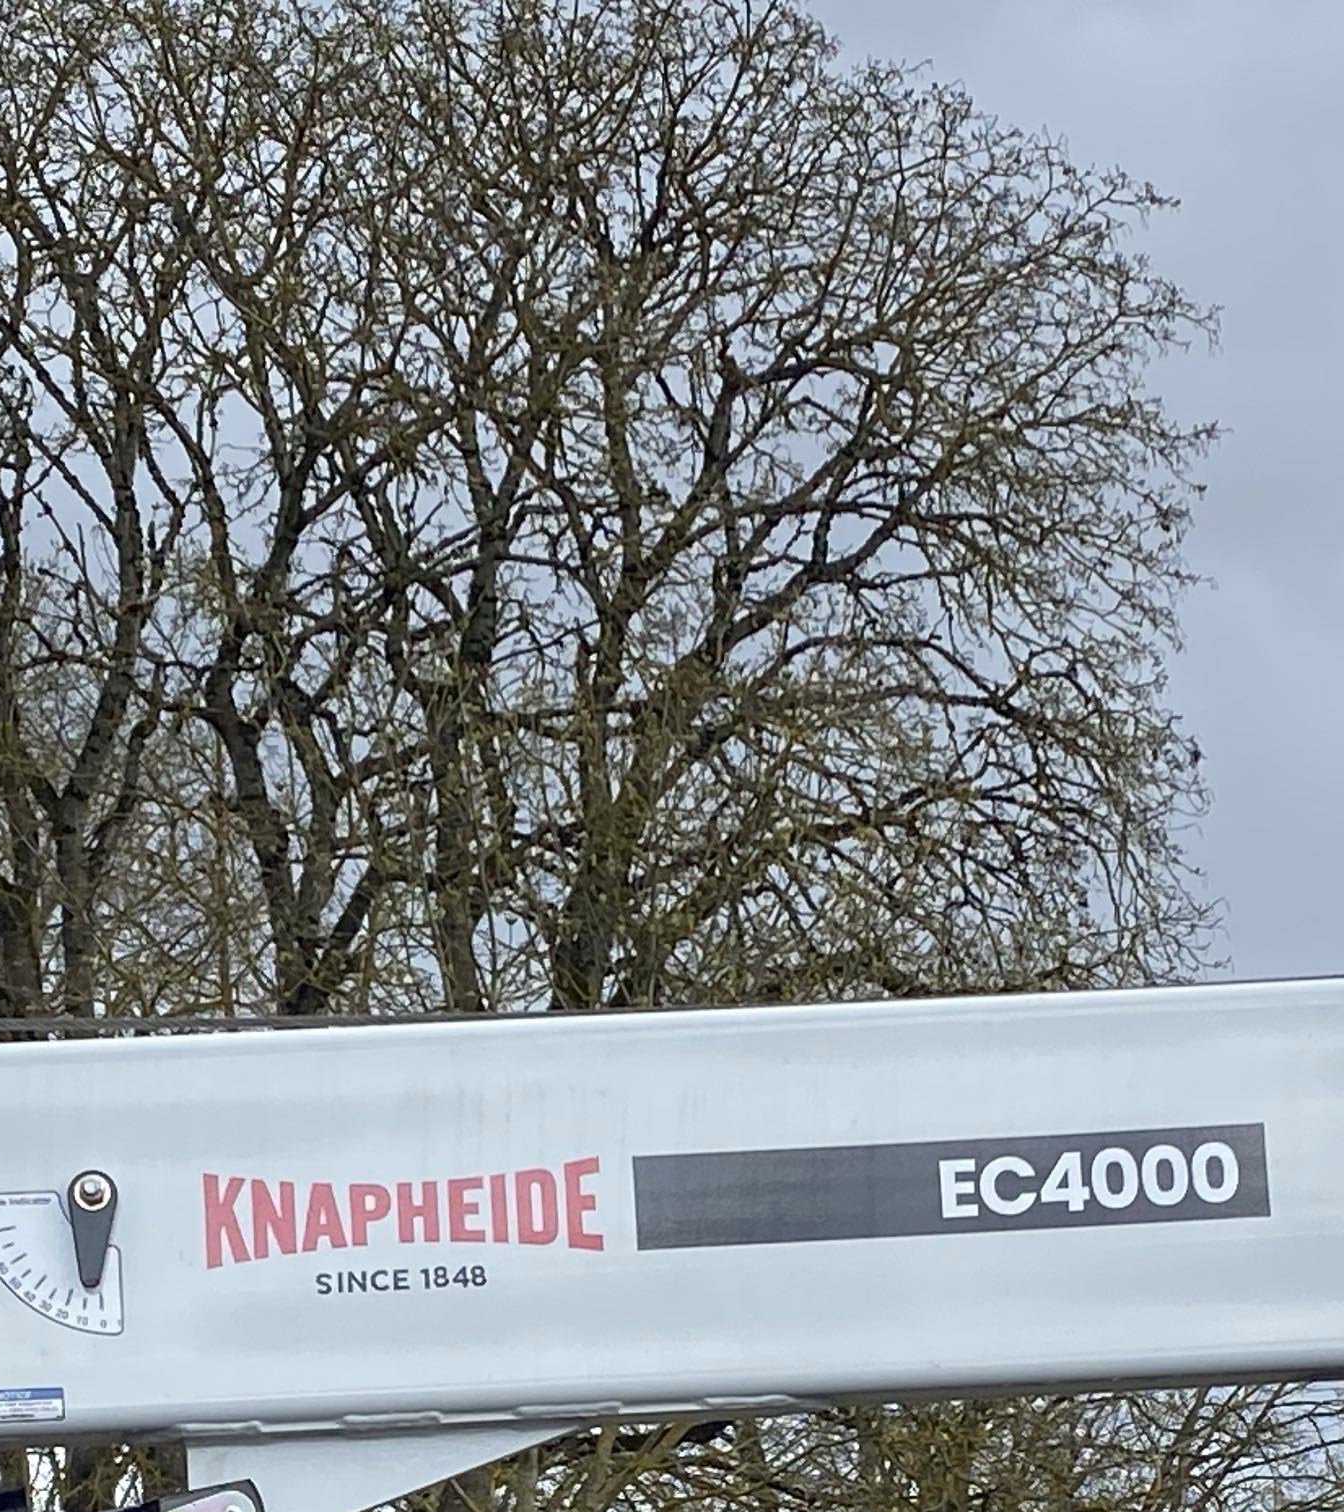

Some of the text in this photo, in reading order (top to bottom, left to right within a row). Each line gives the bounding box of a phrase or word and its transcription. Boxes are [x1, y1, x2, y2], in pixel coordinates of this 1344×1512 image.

[937, 1141, 1239, 1219] EC4000
[202, 1156, 604, 1270] KNAPHEIDE
[9, 1277, 22, 1290] 50
[23, 1291, 36, 1302] 40
[39, 1302, 53, 1312] 30
[56, 1310, 69, 1320] 20
[100, 1320, 107, 1328] 0
[316, 1266, 487, 1295] SINCE 1848
